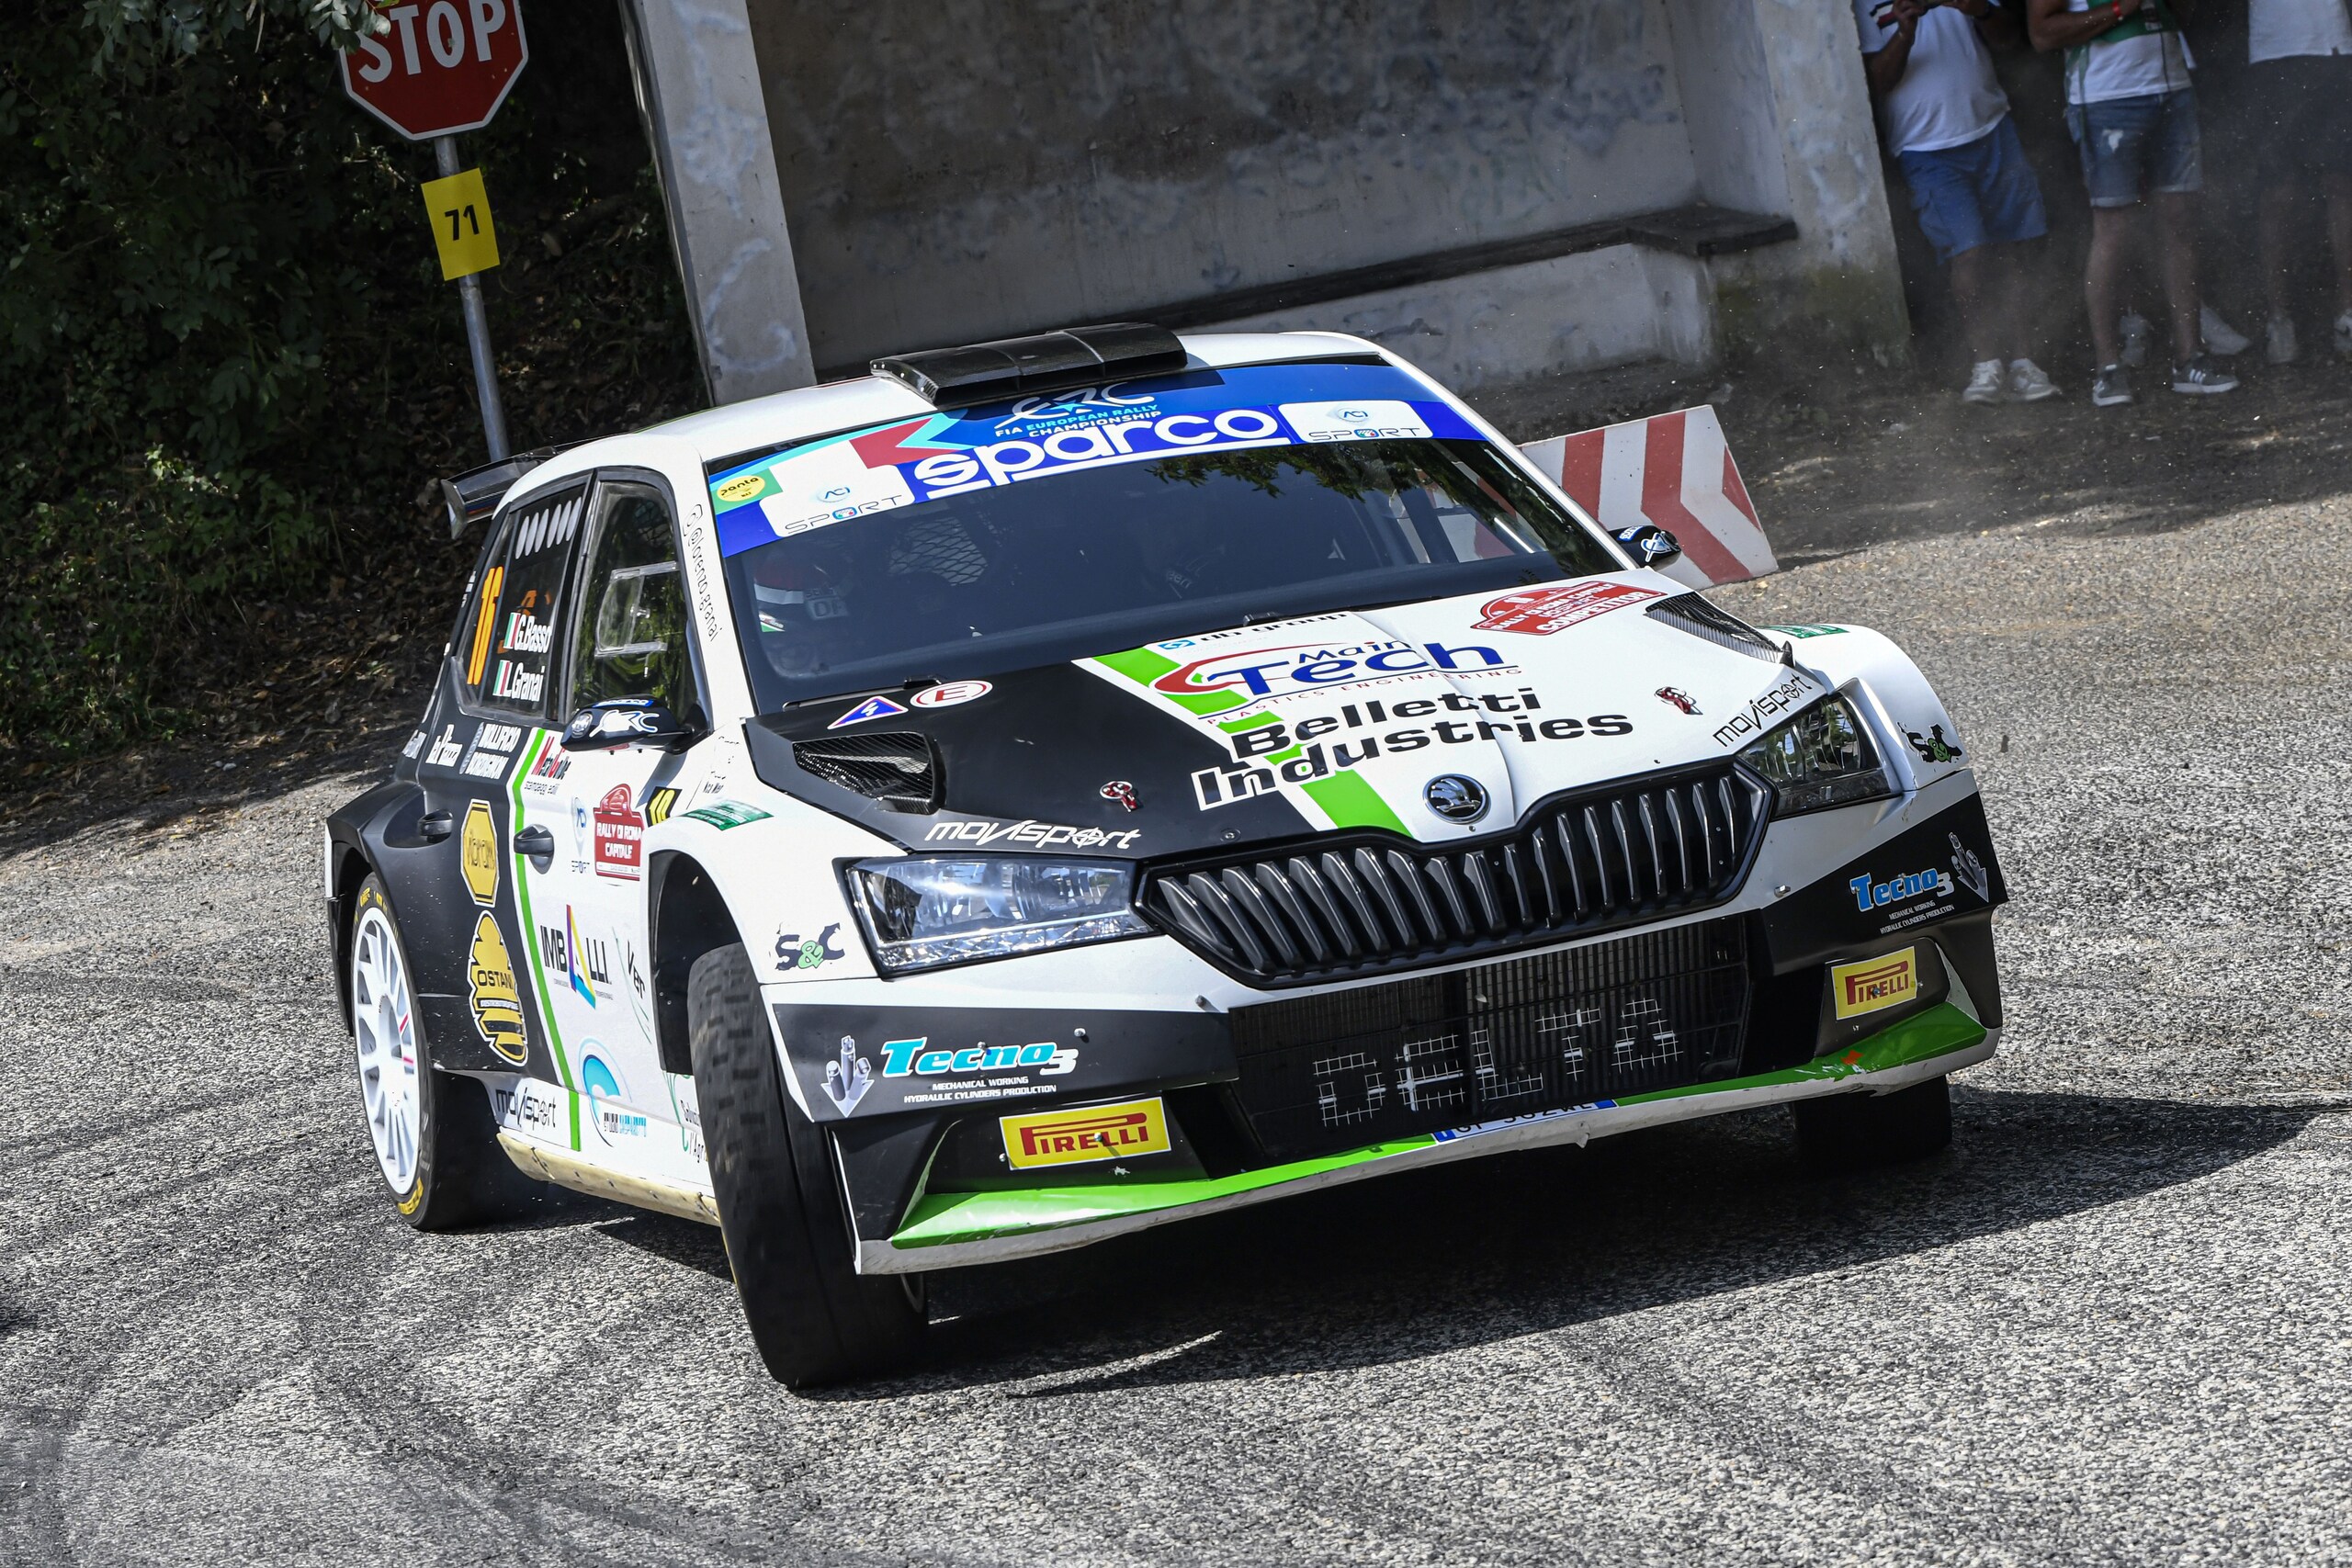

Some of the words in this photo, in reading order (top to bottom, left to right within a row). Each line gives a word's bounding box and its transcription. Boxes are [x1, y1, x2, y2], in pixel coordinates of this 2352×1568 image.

[358, 0, 505, 83] STOP
[445, 204, 480, 242] 71
[995, 426, 1023, 437] FIA
[1026, 412, 1109, 431] EUROPEAN
[1112, 404, 1159, 418] RALLY
[1028, 411, 1162, 438] CHAMPIONSHIP
[913, 409, 1279, 486] sparco
[467, 566, 503, 685] 16
[1535, 591, 1653, 632] COMPETITOR
[1205, 642, 1505, 696] Tech
[1299, 640, 1412, 664] Main
[1207, 689, 1326, 726] PLASTICS
[1340, 668, 1522, 692] ENGINEERING
[1713, 674, 1814, 748] movisport
[1229, 687, 1543, 760] Belletti
[1197, 713, 1634, 807] Industries
[924, 818, 1142, 850] movisport
[1845, 960, 1909, 1006] PIRELLI
[903, 1092, 953, 1103] HYDRAULIC
[954, 1089, 1001, 1100] CYLINDERS
[1002, 1085, 1057, 1097] PRODUCTION
[932, 1079, 987, 1091] MECHANICAL
[989, 1076, 1029, 1087] WORKING
[1020, 1111, 1149, 1156] PIRELLI
